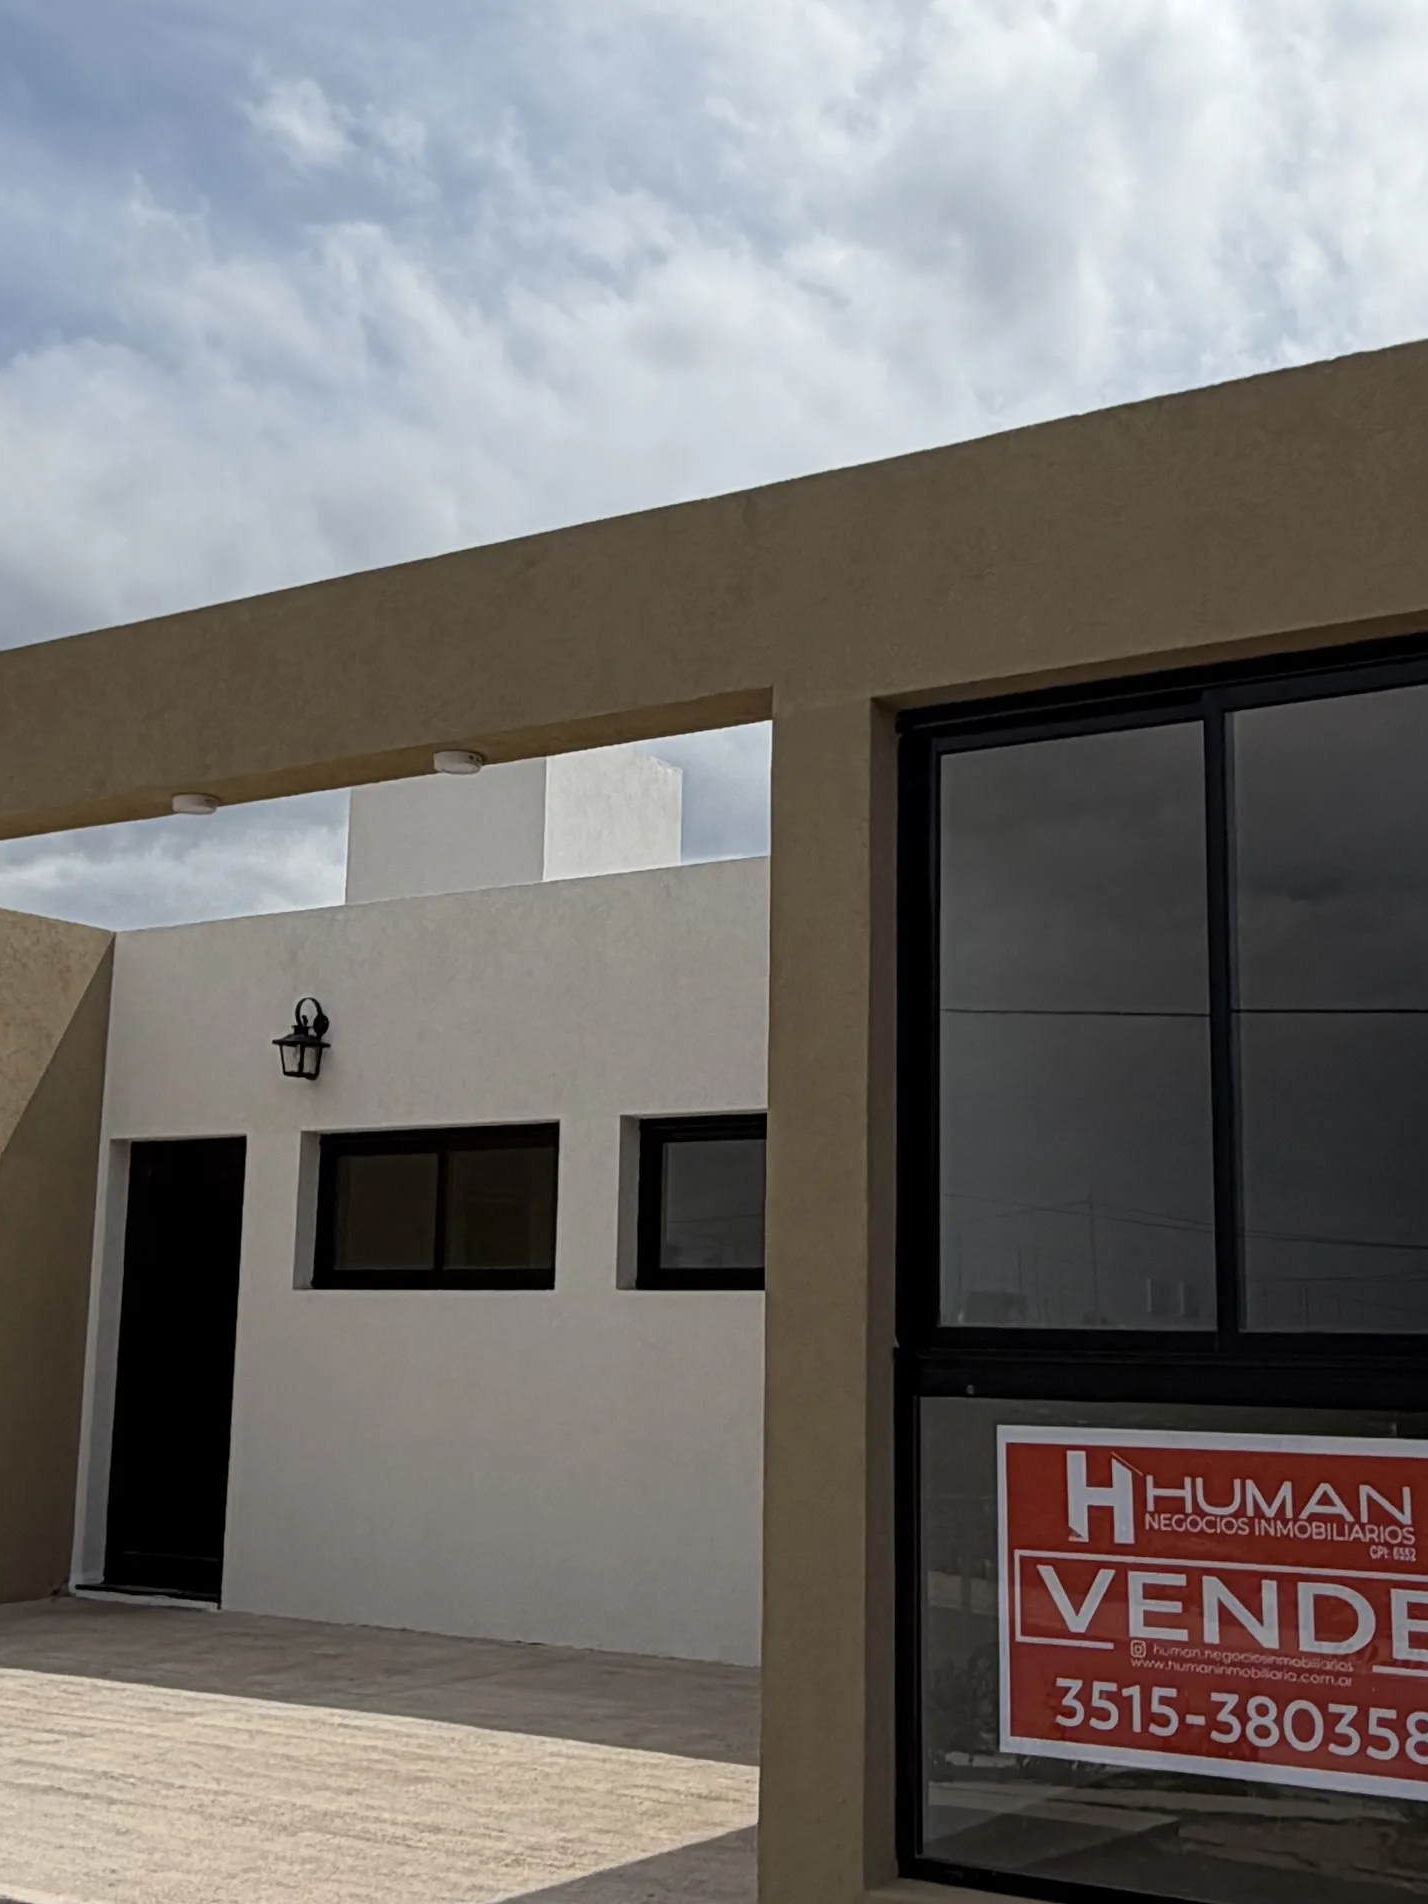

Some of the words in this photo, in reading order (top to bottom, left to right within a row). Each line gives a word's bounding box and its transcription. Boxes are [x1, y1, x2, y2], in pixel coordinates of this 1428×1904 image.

[1145, 1474, 1413, 1526] HUMAN
[1144, 1513, 1250, 1536] NEGOCIOS
[1254, 1520, 1416, 1545] INMOBILIARIOS
